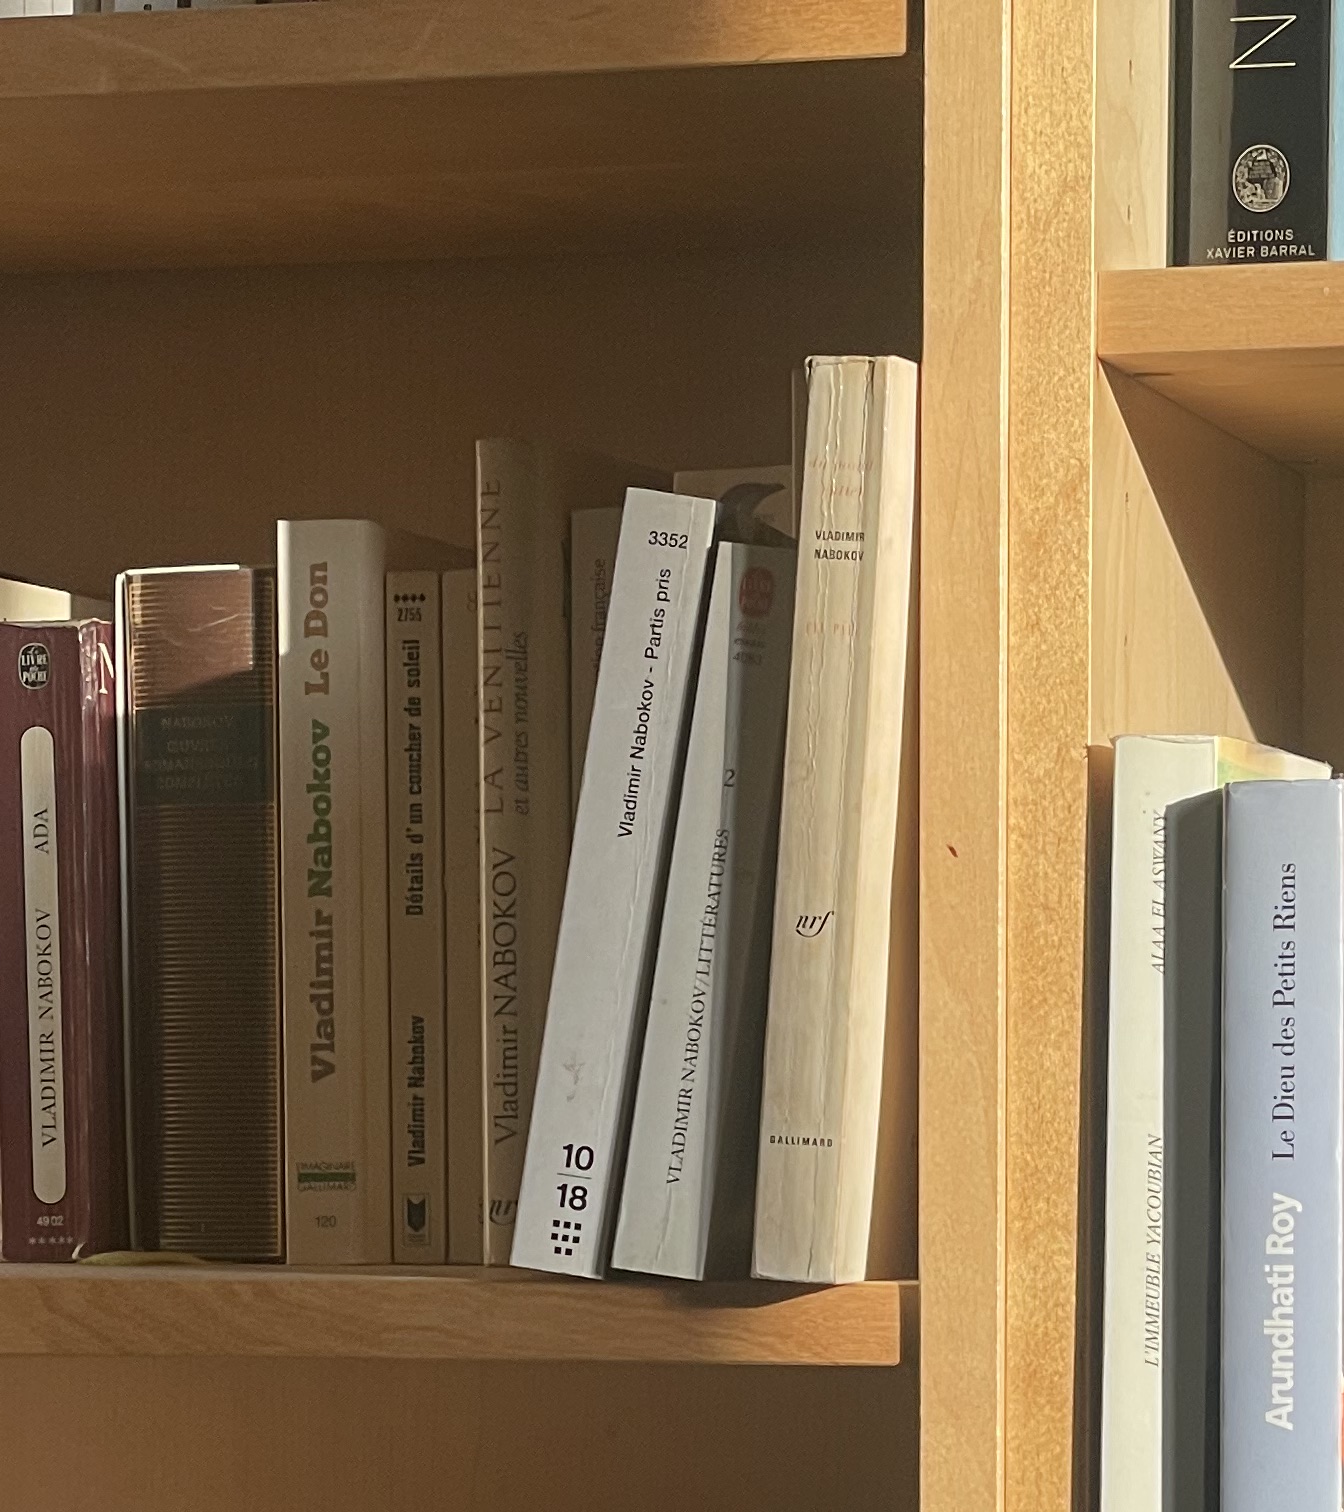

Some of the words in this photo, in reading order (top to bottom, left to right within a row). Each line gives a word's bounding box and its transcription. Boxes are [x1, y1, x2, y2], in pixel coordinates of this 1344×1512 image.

[1206, 245, 1255, 260] XAVIER
[1260, 243, 1316, 258] BARRAL
[1228, 229, 1294, 243] ÉDITIONS
[648, 531, 689, 549] 3352
[304, 561, 329, 639] Don
[305, 648, 329, 697] Le
[617, 765, 642, 838] Vladimir
[630, 679, 653, 759] Nabokov
[645, 607, 665, 660] Partis
[657, 568, 671, 604] pris
[33, 808, 49, 855] ADA
[306, 718, 333, 898] Nabokov
[1272, 862, 1297, 932] Riens
[36, 908, 53, 1022] NABOKOV
[309, 910, 336, 1084] Vladimir
[1272, 940, 1297, 1010] Petits
[407, 1015, 425, 1088] Nabokov
[1272, 1016, 1296, 1059] des
[42, 1031, 58, 1148] VLADIMIR
[1272, 1066, 1296, 1130] Dieu
[407, 1095, 425, 1168] Vladimir
[563, 1144, 594, 1171] 10
[1272, 1131, 1295, 1161] Le
[557, 1184, 588, 1211] 18
[1264, 1192, 1302, 1246] Roy
[1264, 1256, 1296, 1431] Arundhati
